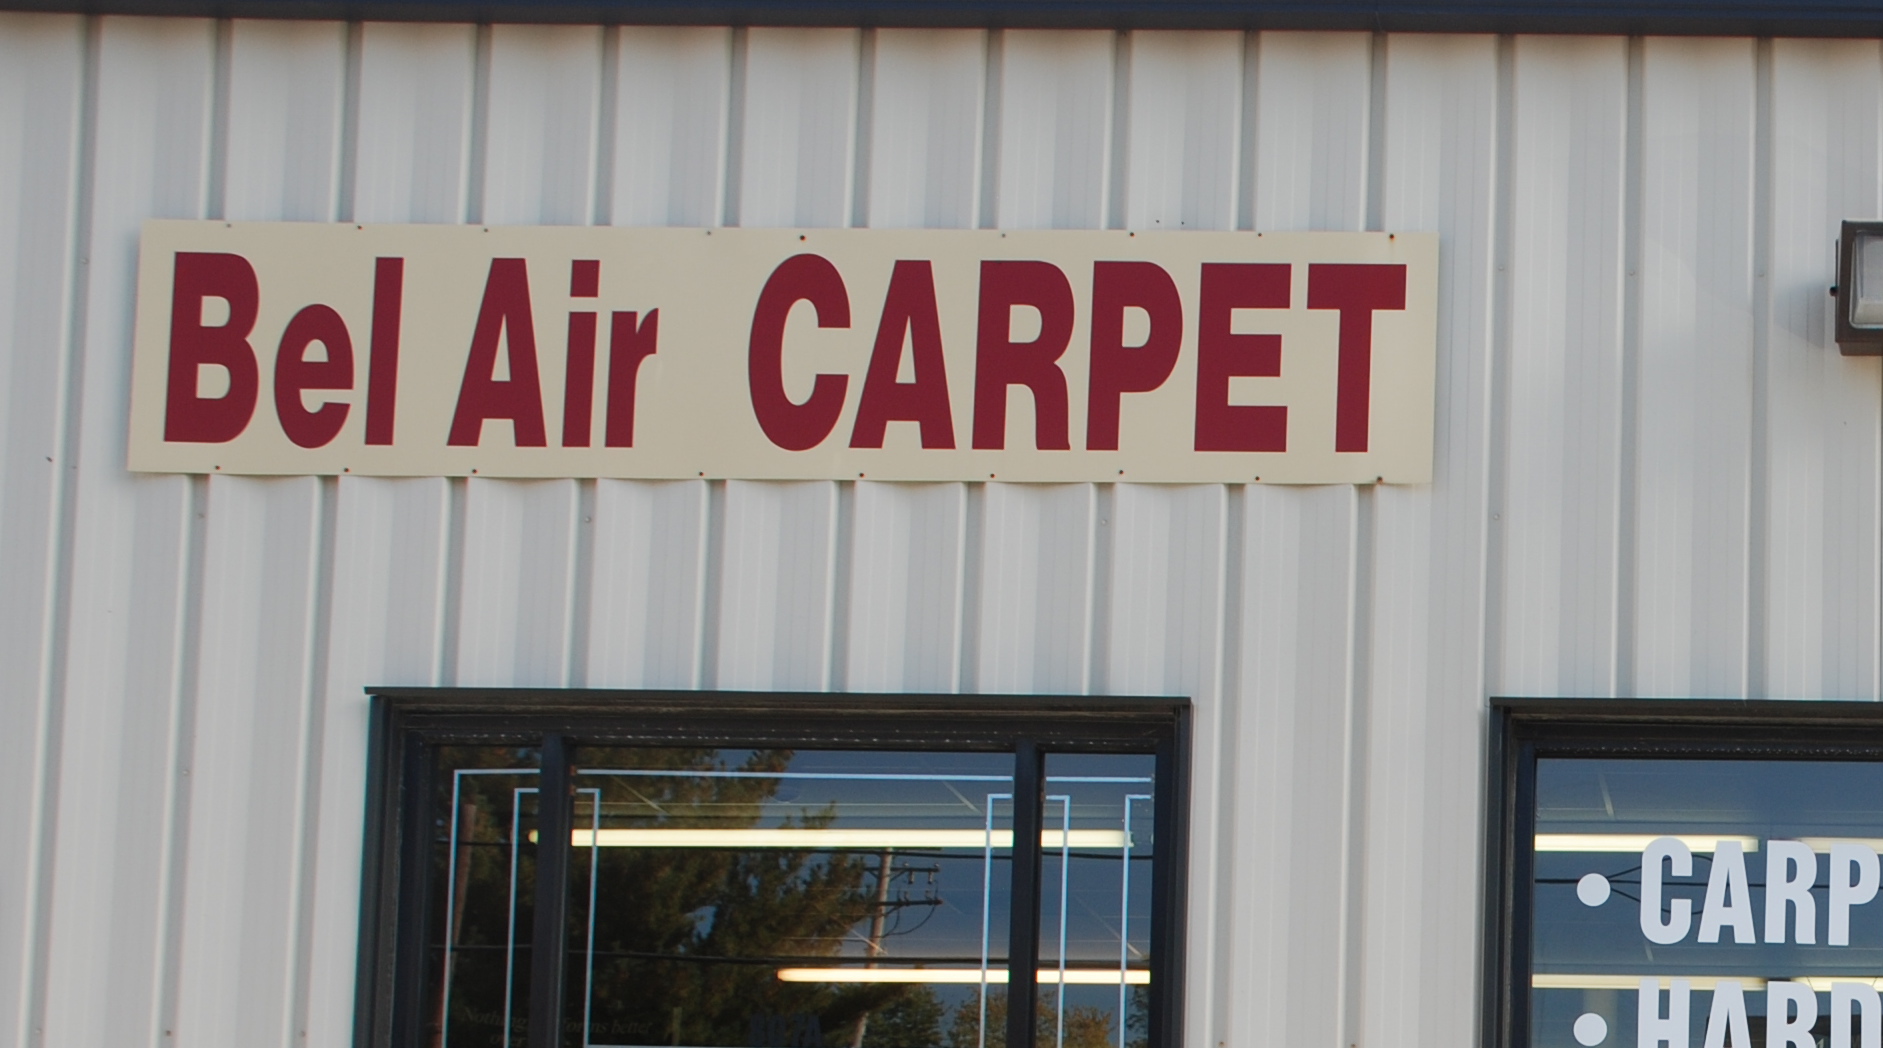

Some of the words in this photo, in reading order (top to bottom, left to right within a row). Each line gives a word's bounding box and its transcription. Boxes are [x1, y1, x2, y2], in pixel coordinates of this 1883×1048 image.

[163, 252, 404, 449] Bel
[447, 257, 659, 448] Air
[748, 253, 1407, 453] CARPET
